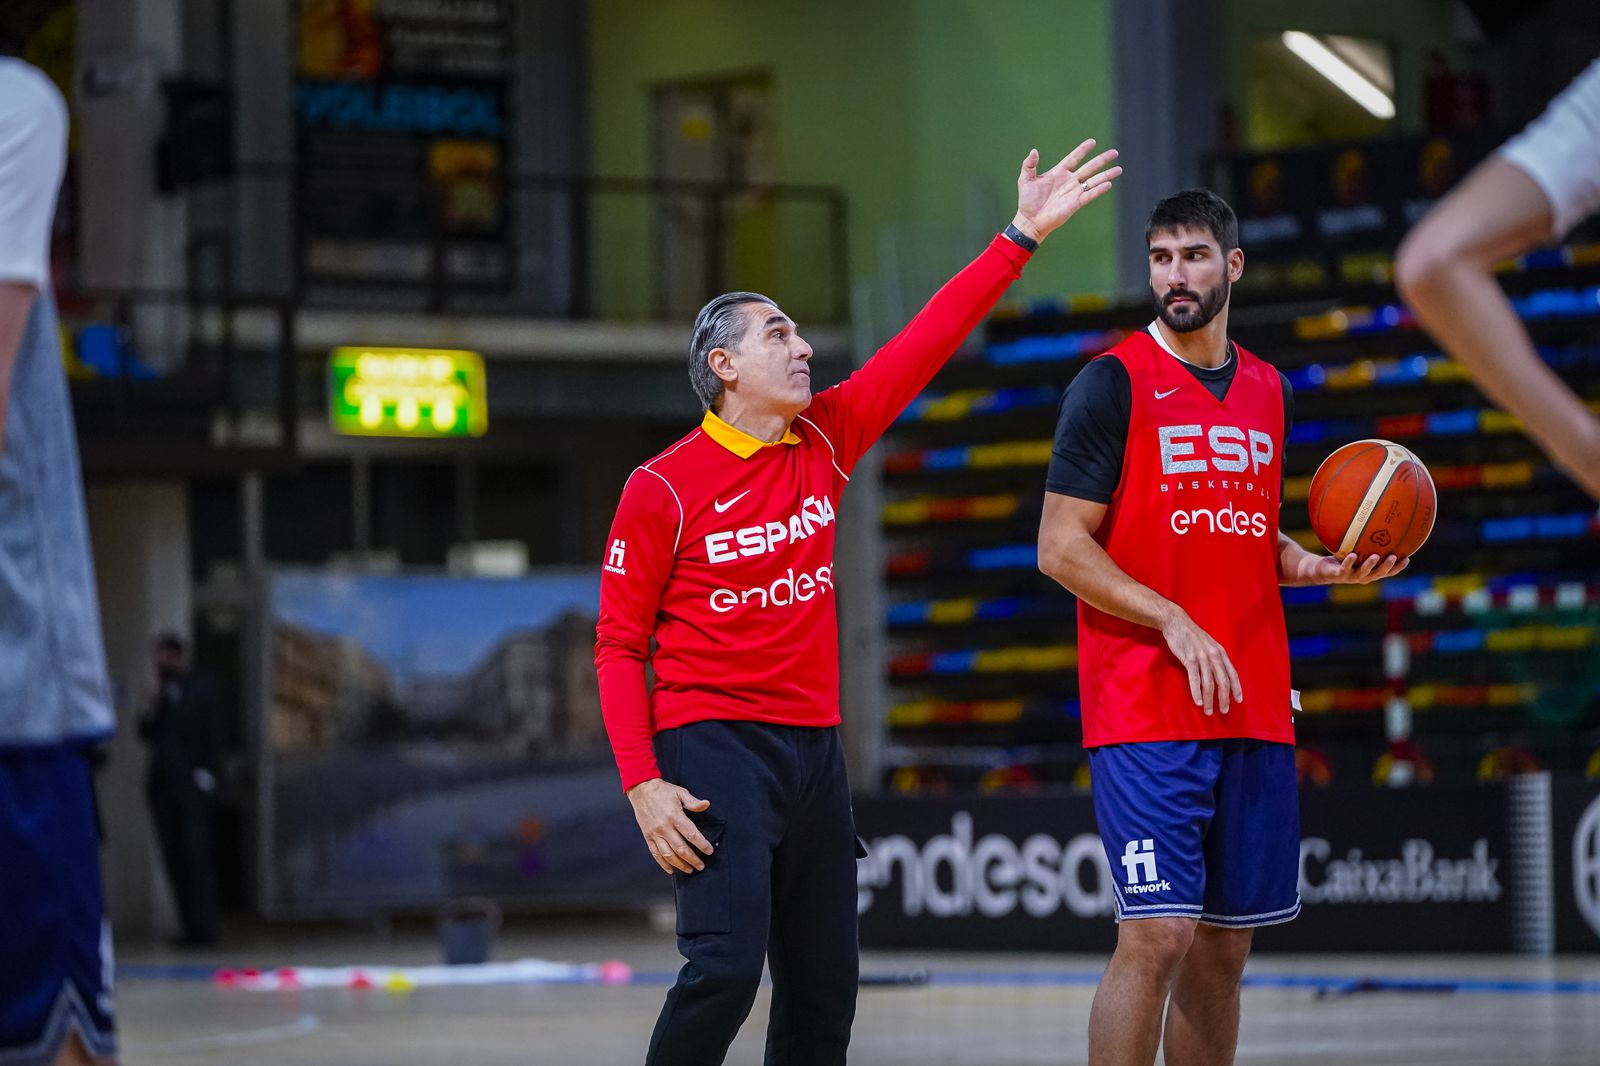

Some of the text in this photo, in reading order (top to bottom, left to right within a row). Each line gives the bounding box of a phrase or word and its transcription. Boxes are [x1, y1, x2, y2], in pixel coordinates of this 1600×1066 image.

[1157, 424, 1274, 476] ESP
[1160, 480, 1269, 499] BASKETBLL
[705, 495, 835, 564] ESPAÑA
[1170, 501, 1267, 537] endes
[710, 562, 834, 612] endes
[1121, 838, 1158, 884] fi
[1299, 837, 1502, 902] CaixaBank
